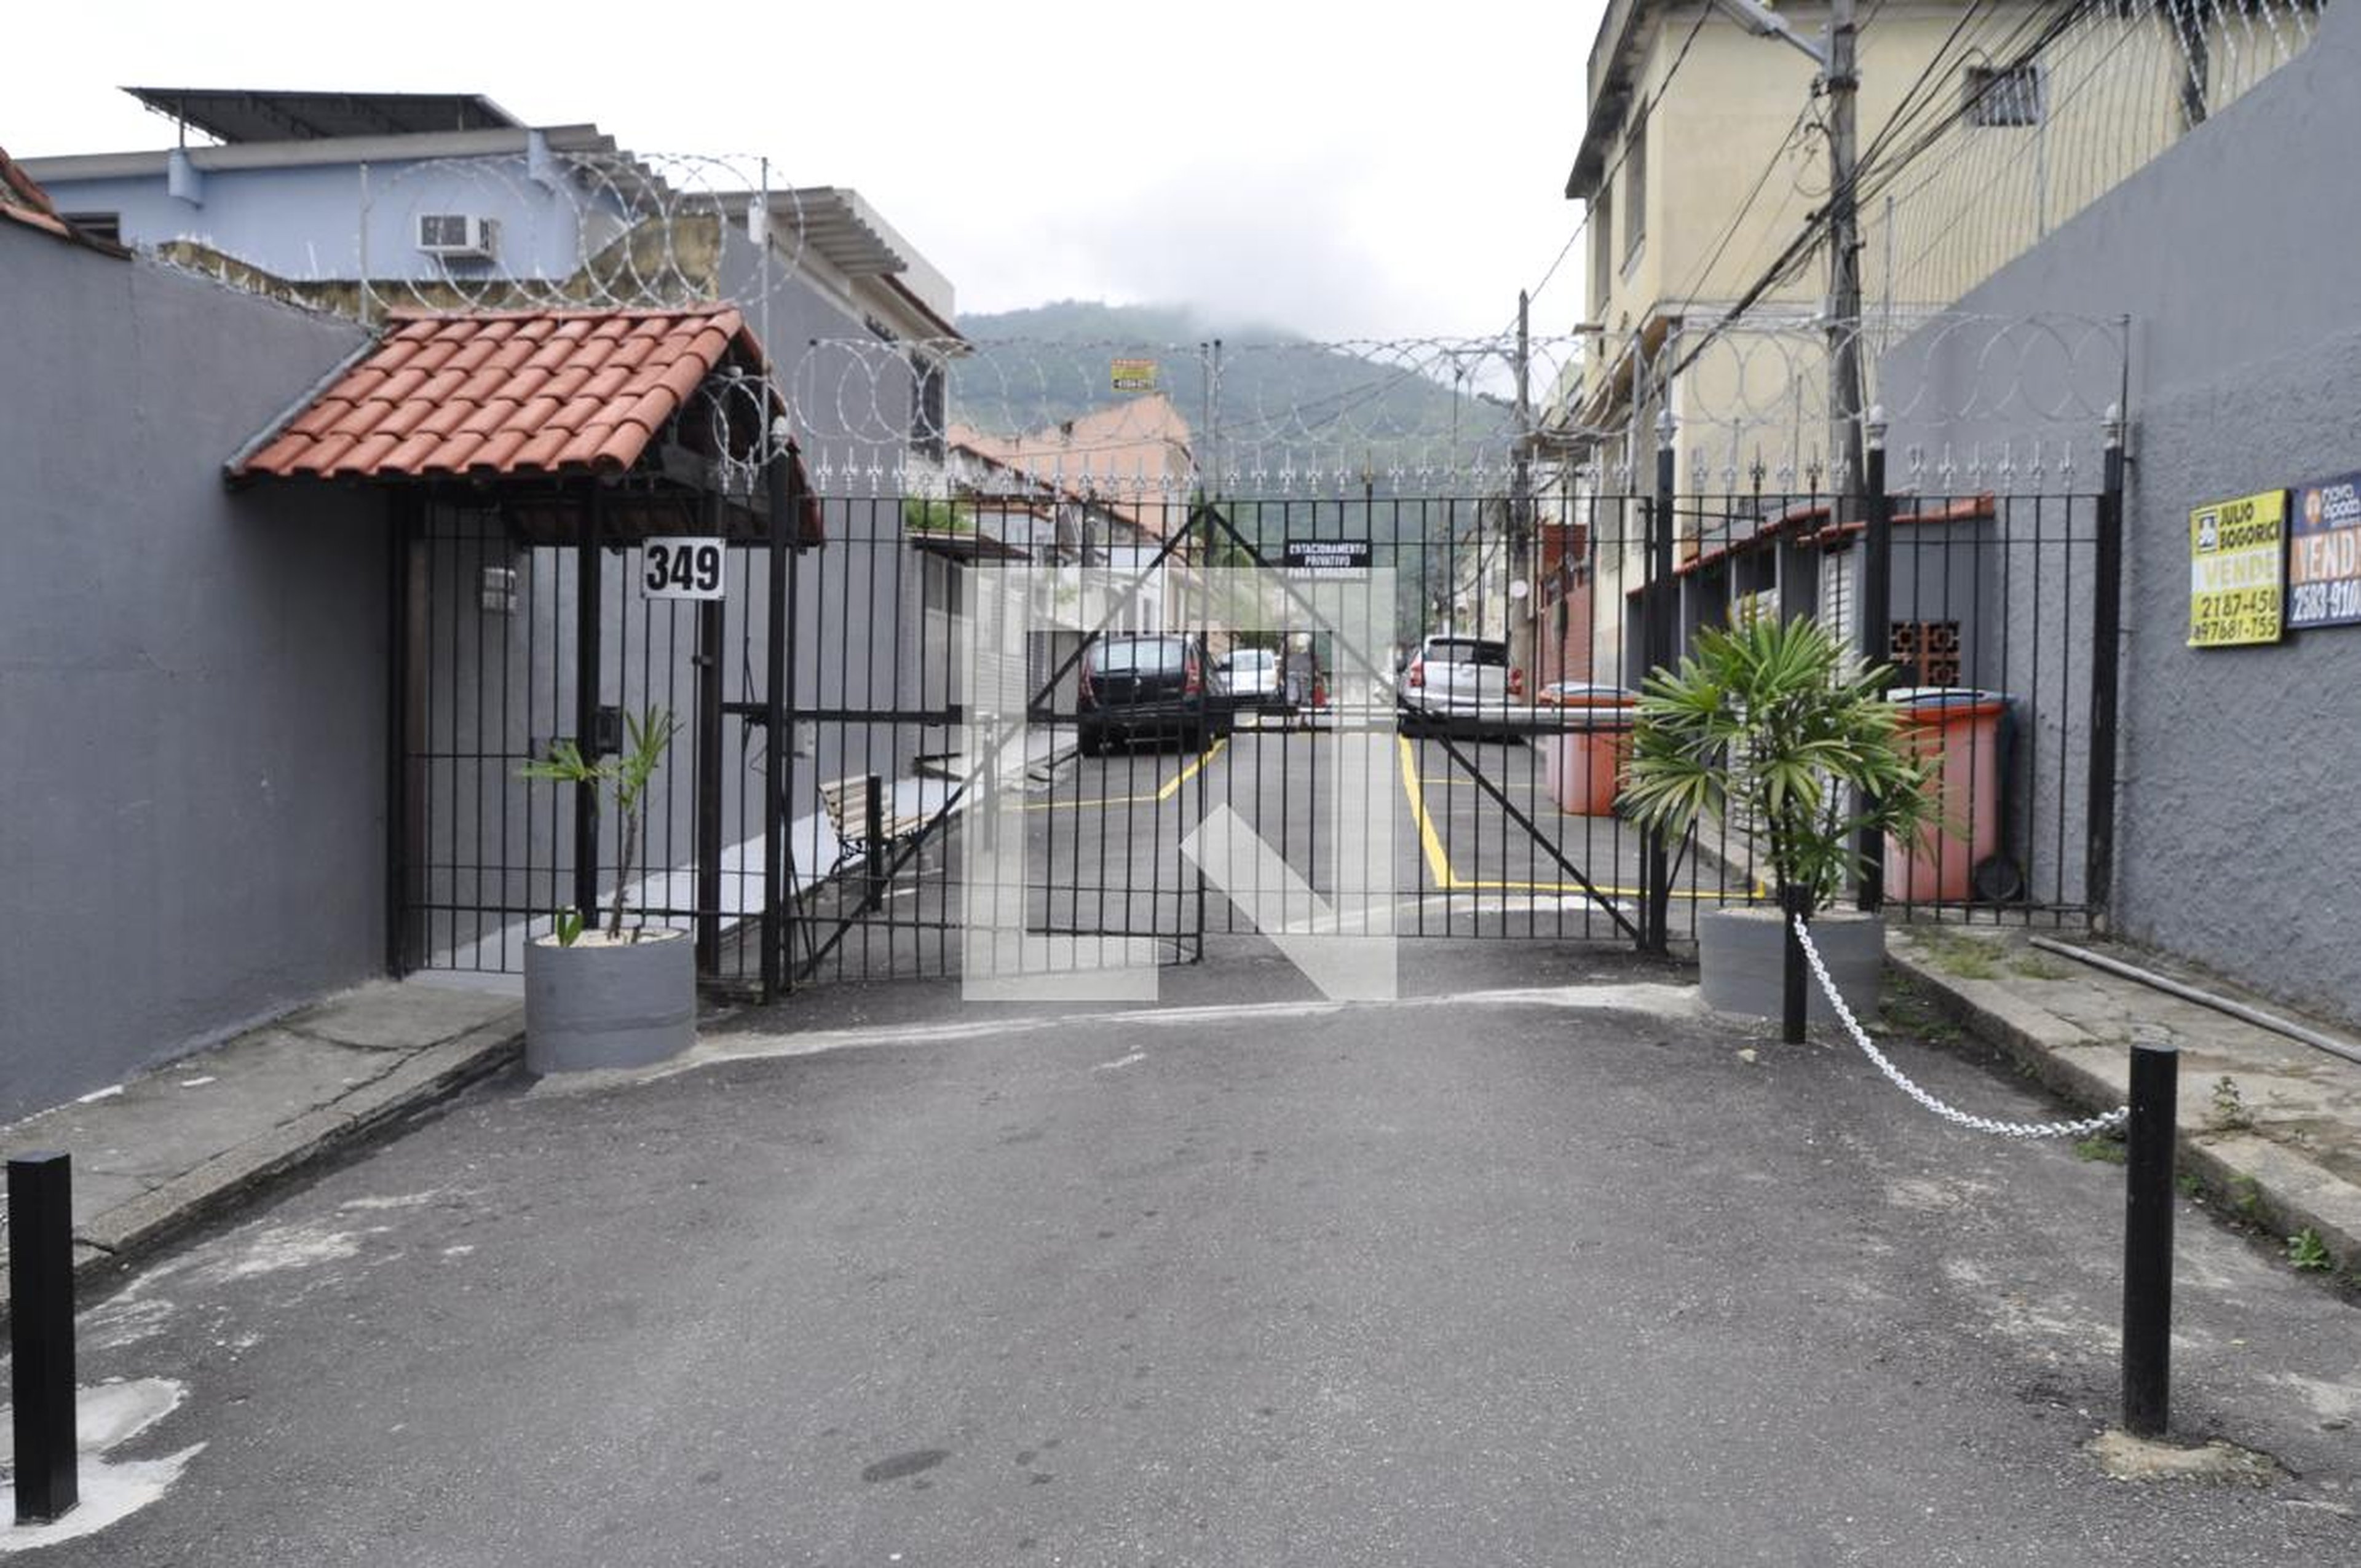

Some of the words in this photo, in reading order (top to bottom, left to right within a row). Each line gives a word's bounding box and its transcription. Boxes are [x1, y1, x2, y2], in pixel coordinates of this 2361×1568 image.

[2220, 502, 2254, 527] JULIO
[647, 545, 719, 591] 349
[1304, 555, 1351, 566] PRIVATIVO
